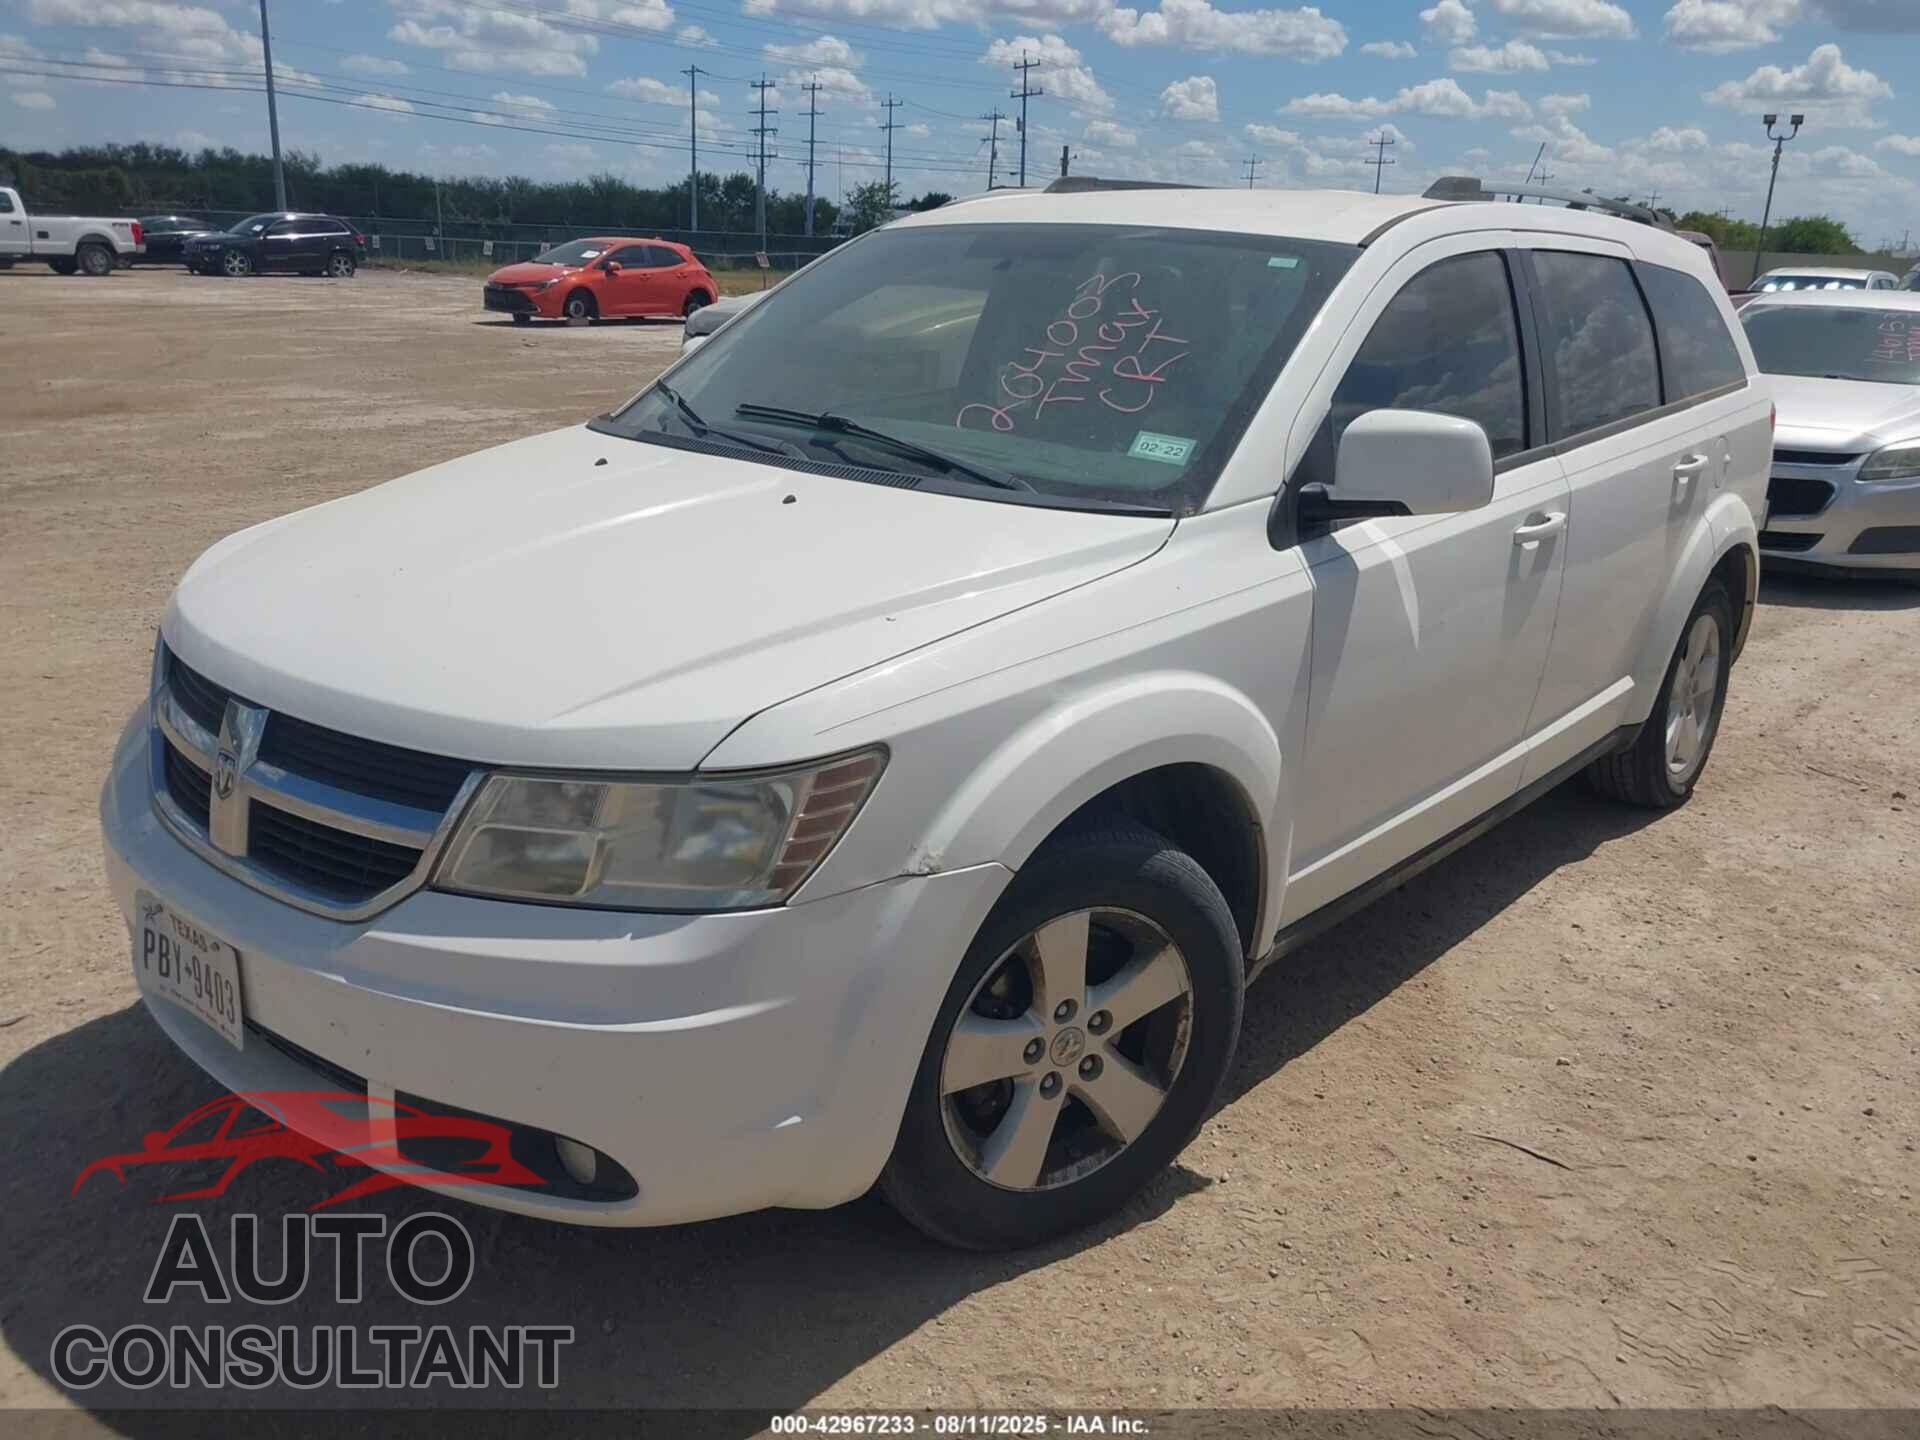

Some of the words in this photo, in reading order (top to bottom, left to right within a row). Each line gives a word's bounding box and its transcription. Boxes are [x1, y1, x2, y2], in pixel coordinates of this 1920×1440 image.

[1099, 318, 1191, 413] CRT
[1163, 445, 1184, 457] 22
[169, 913, 208, 953] TEXAS
